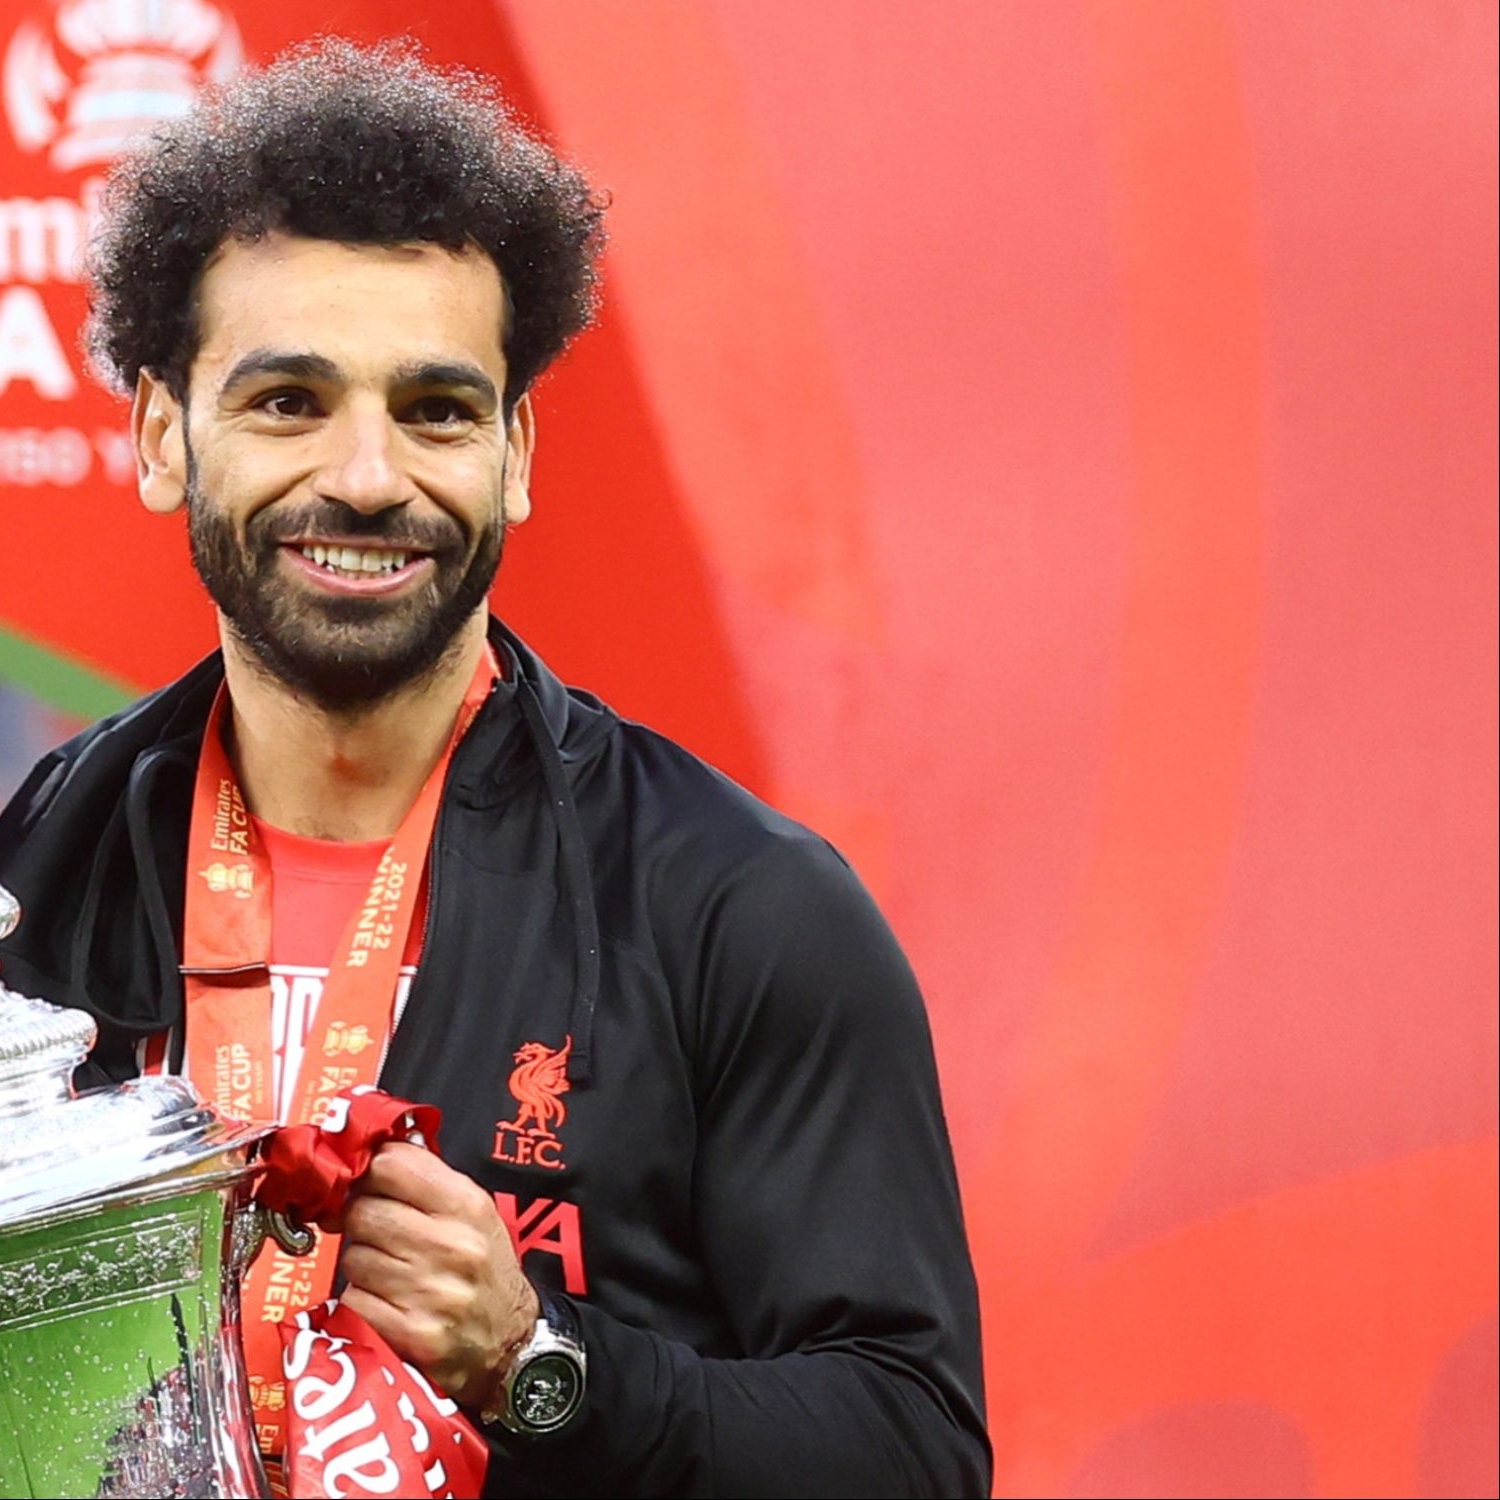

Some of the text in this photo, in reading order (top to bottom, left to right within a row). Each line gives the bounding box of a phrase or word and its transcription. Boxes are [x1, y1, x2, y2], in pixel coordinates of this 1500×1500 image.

[210, 779, 231, 851] Emirates
[230, 831, 248, 856] FA
[372, 863, 407, 949] 2021-22
[231, 1043, 251, 1090] CUP
[318, 1066, 340, 1093] FA
[492, 1131, 566, 1169] L.F.C.
[260, 1250, 296, 1323] NER
